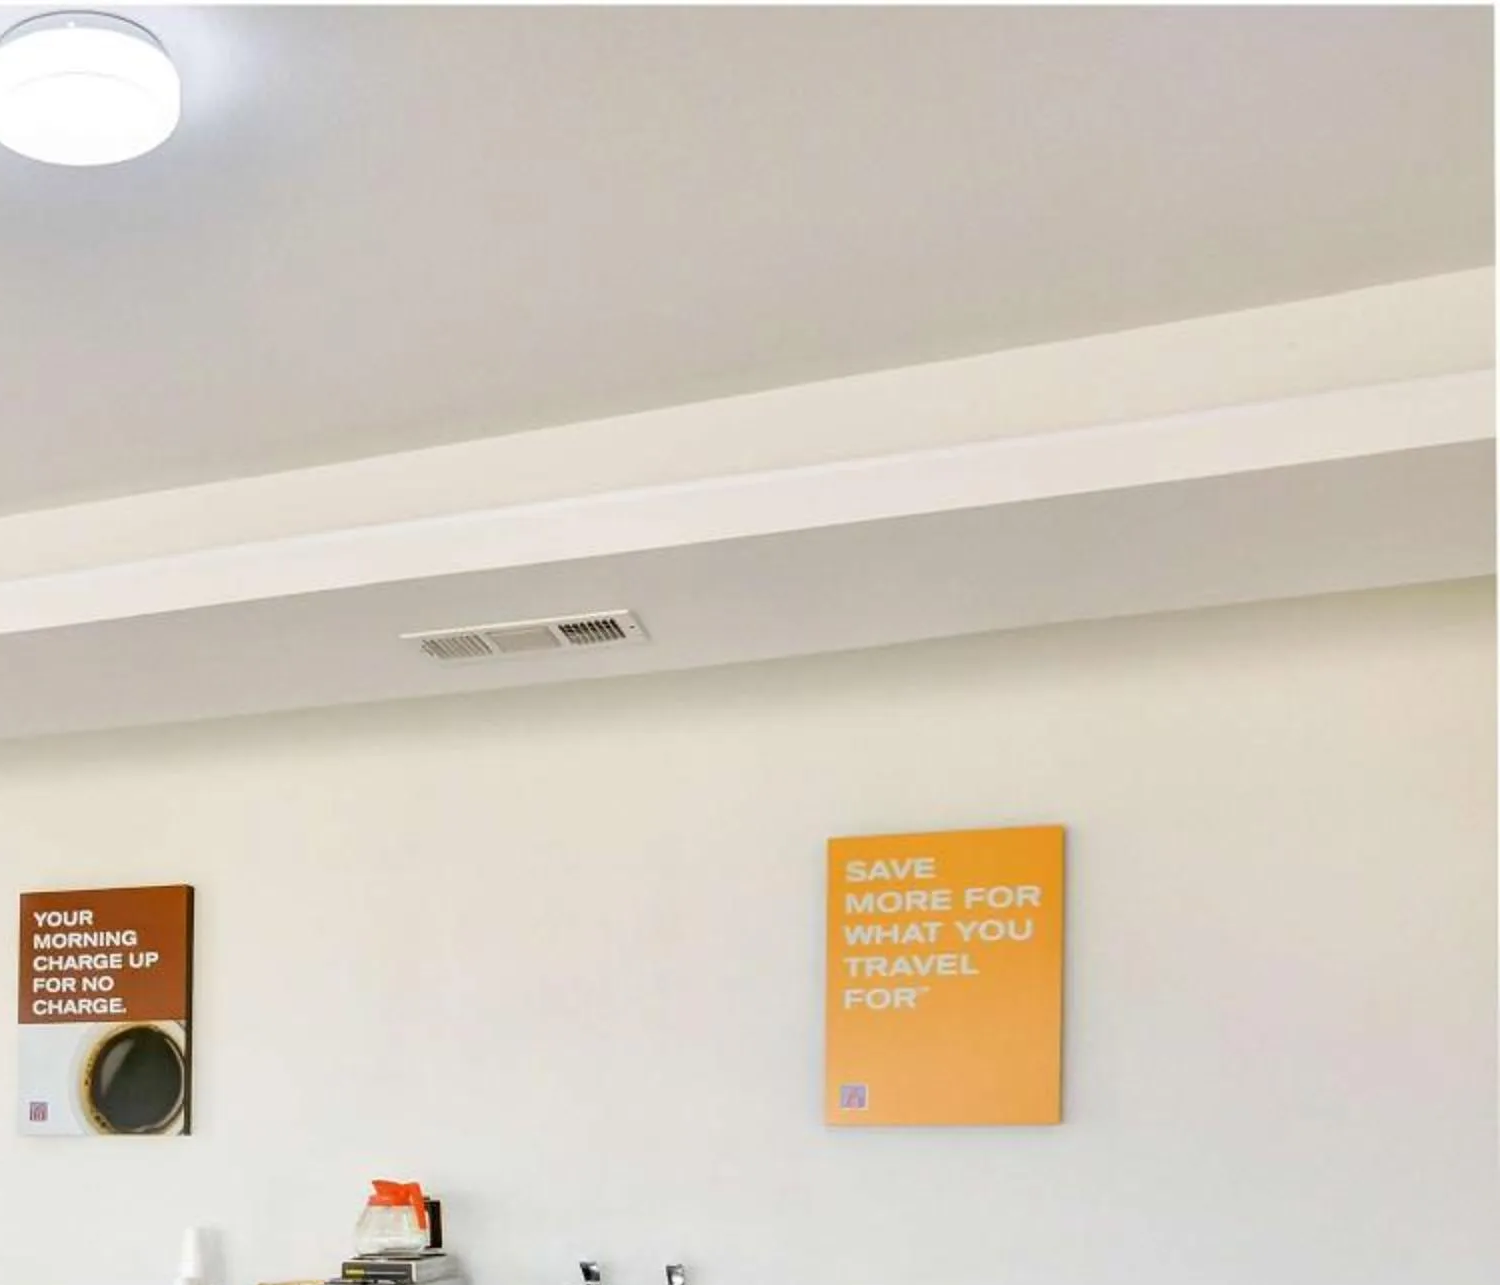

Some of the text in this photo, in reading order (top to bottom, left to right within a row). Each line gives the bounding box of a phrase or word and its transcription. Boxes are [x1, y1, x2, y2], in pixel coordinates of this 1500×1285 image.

[845, 857, 936, 882] SAVE
[845, 885, 1041, 914] MORE FOR
[33, 911, 94, 927] YOUR
[33, 931, 137, 949] MORNING
[843, 919, 1033, 945] WHAT YOU
[33, 951, 159, 971] CHARGE UP
[843, 953, 980, 977] TRAVEL
[33, 975, 115, 993] FOR NO
[33, 997, 127, 1016] CHARGE.
